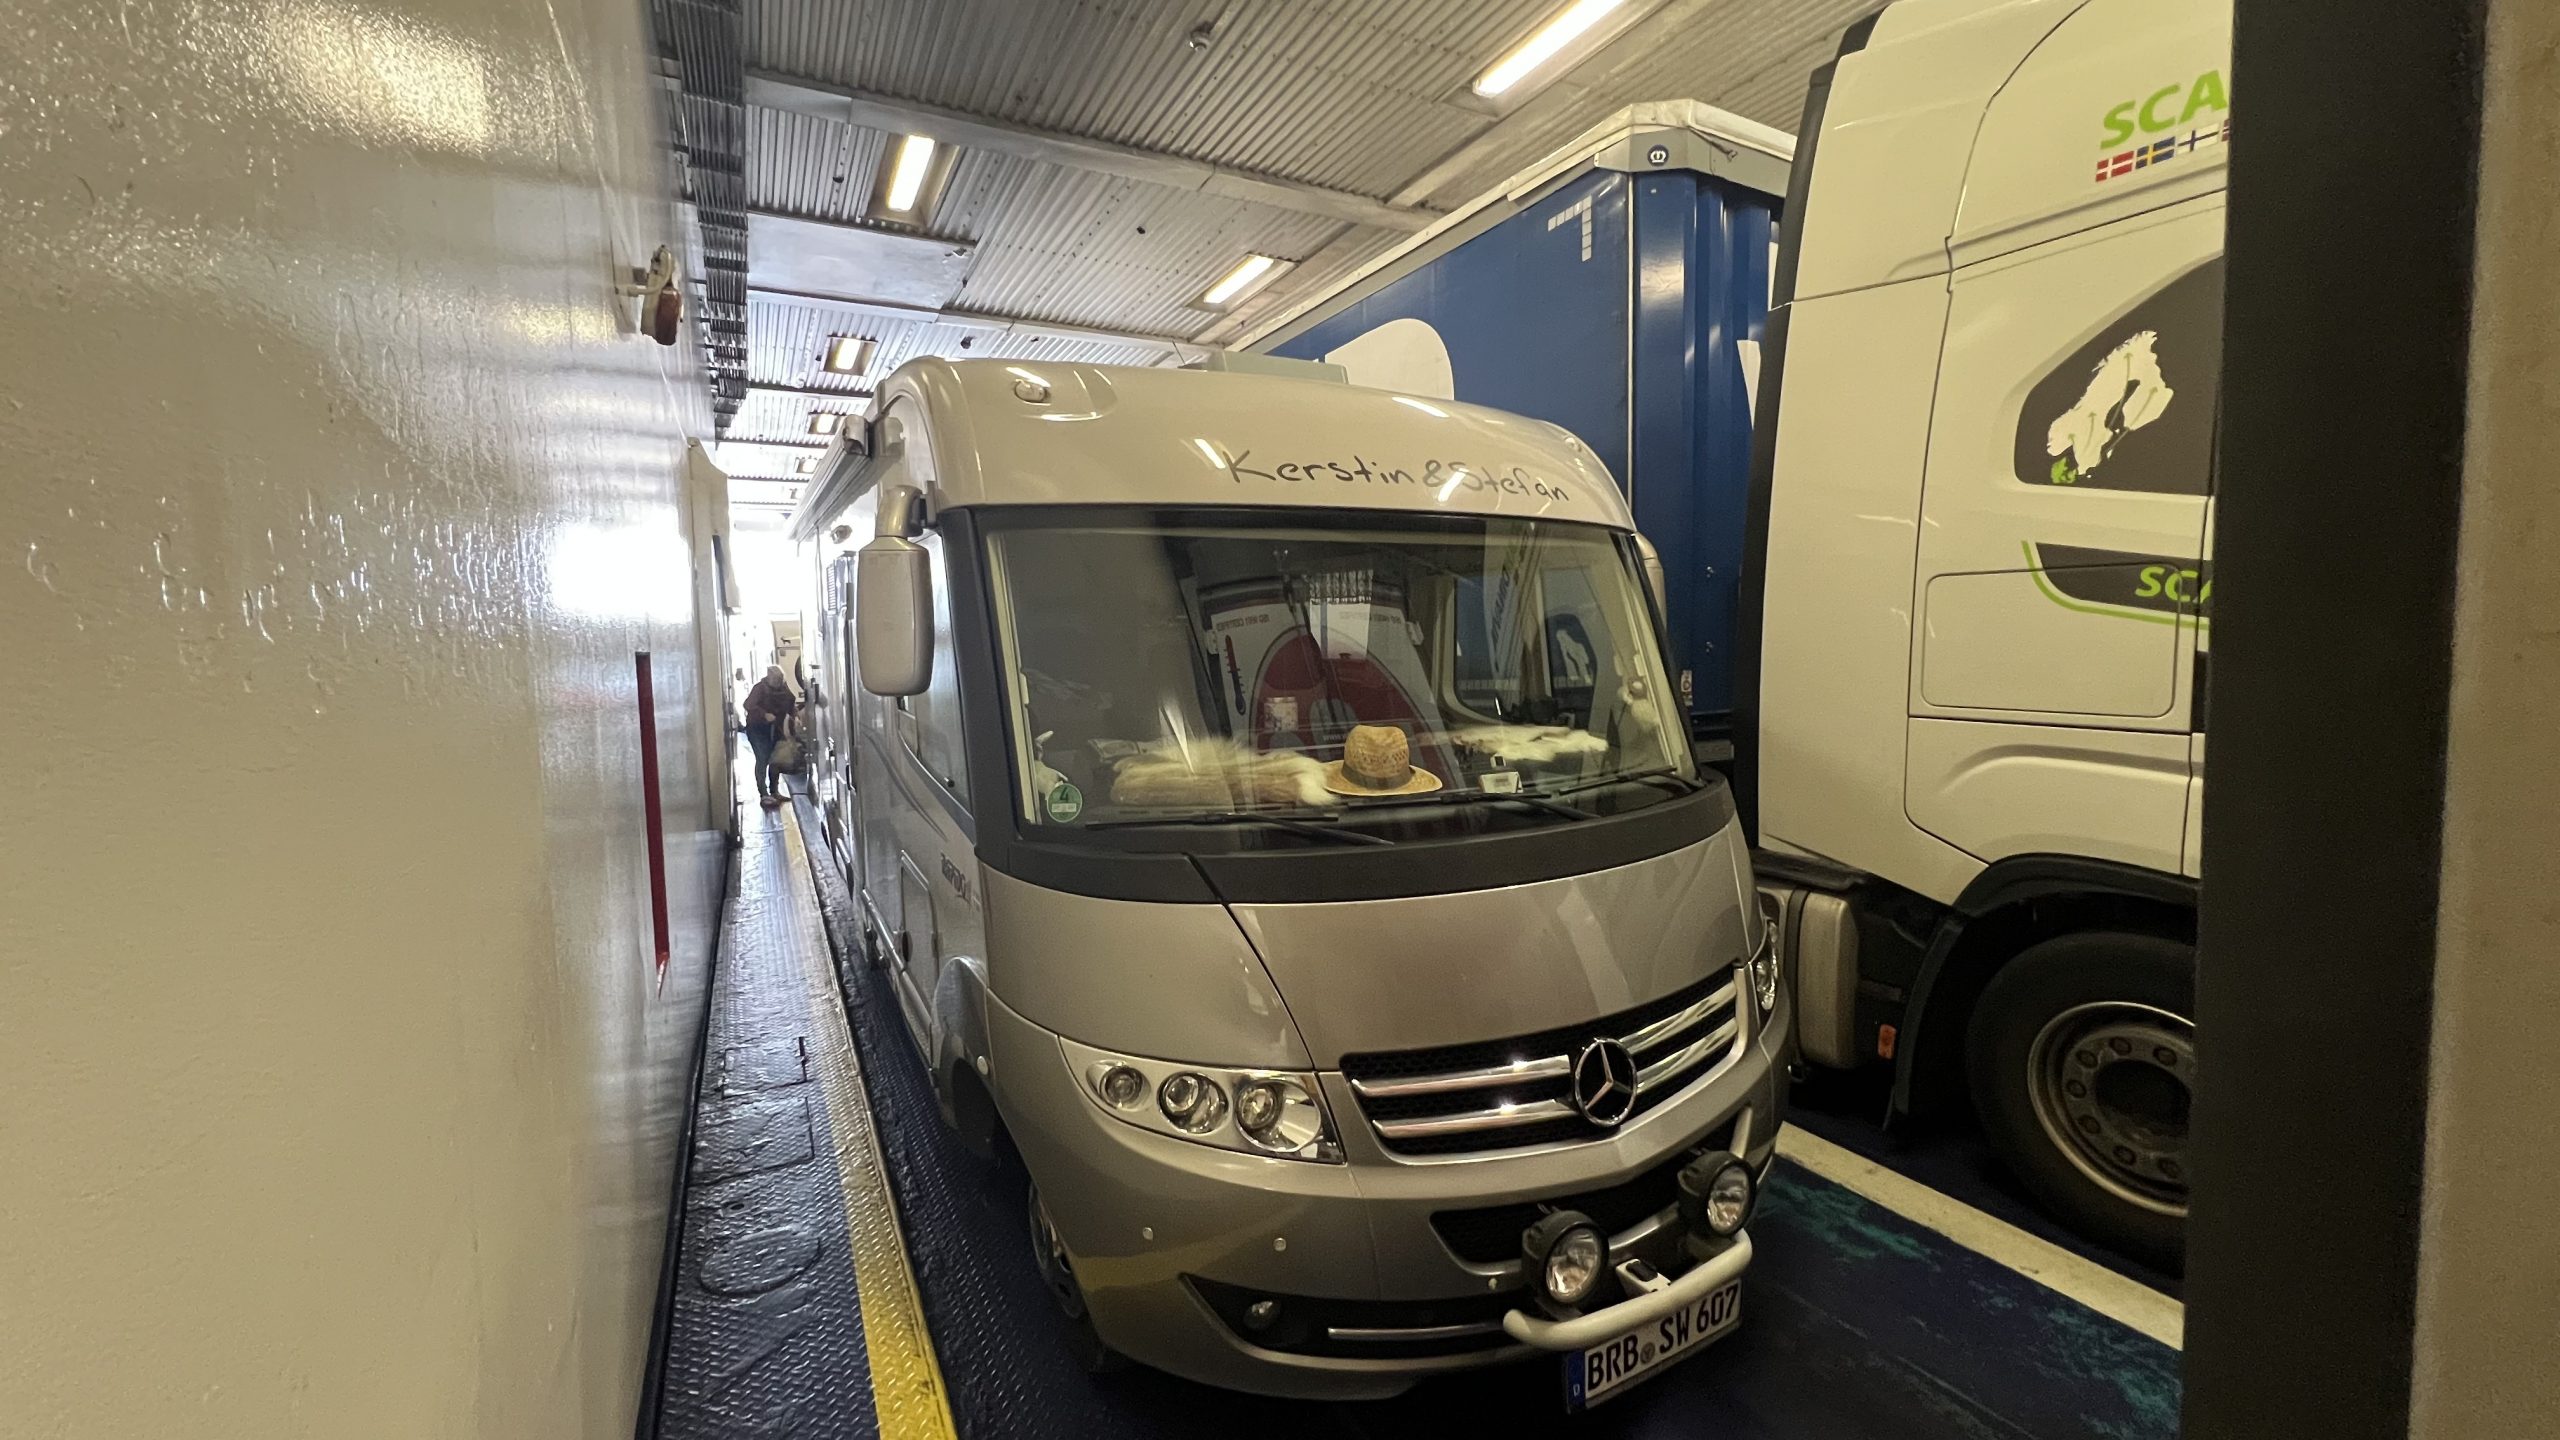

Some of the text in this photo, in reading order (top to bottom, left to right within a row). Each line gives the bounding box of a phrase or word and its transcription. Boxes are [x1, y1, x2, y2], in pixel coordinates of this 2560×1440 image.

[1587, 1283, 1739, 1391] BRB SW 607
